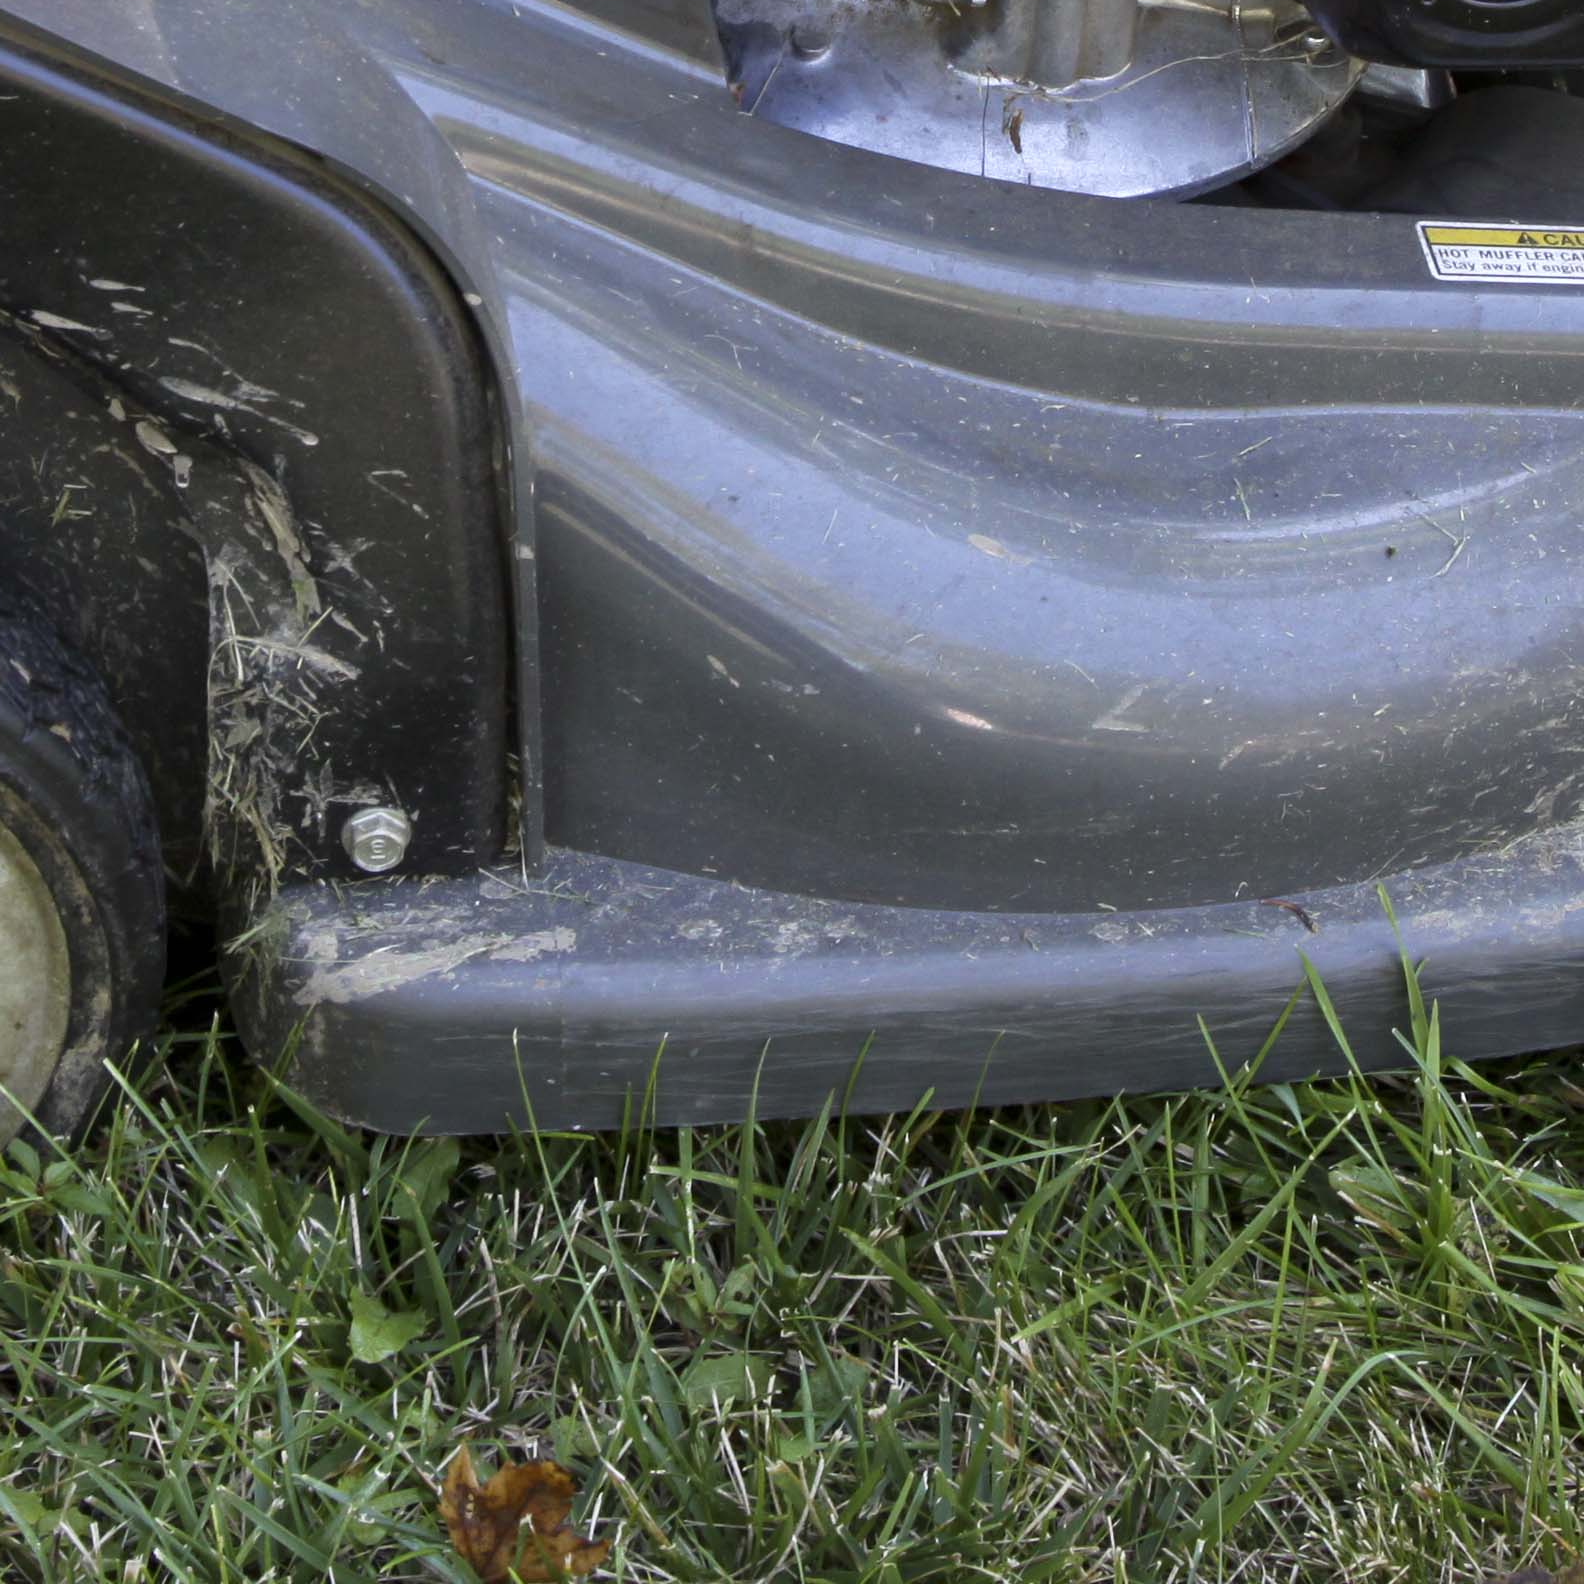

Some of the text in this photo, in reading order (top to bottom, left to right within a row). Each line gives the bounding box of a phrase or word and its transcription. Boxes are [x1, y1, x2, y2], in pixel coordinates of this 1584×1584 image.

[1437, 248, 1470, 259] HOT
[1479, 249, 1554, 261] MUFFLER
[1442, 259, 1476, 271] Stay
[1482, 262, 1522, 273] away
[1527, 261, 1538, 272] if
